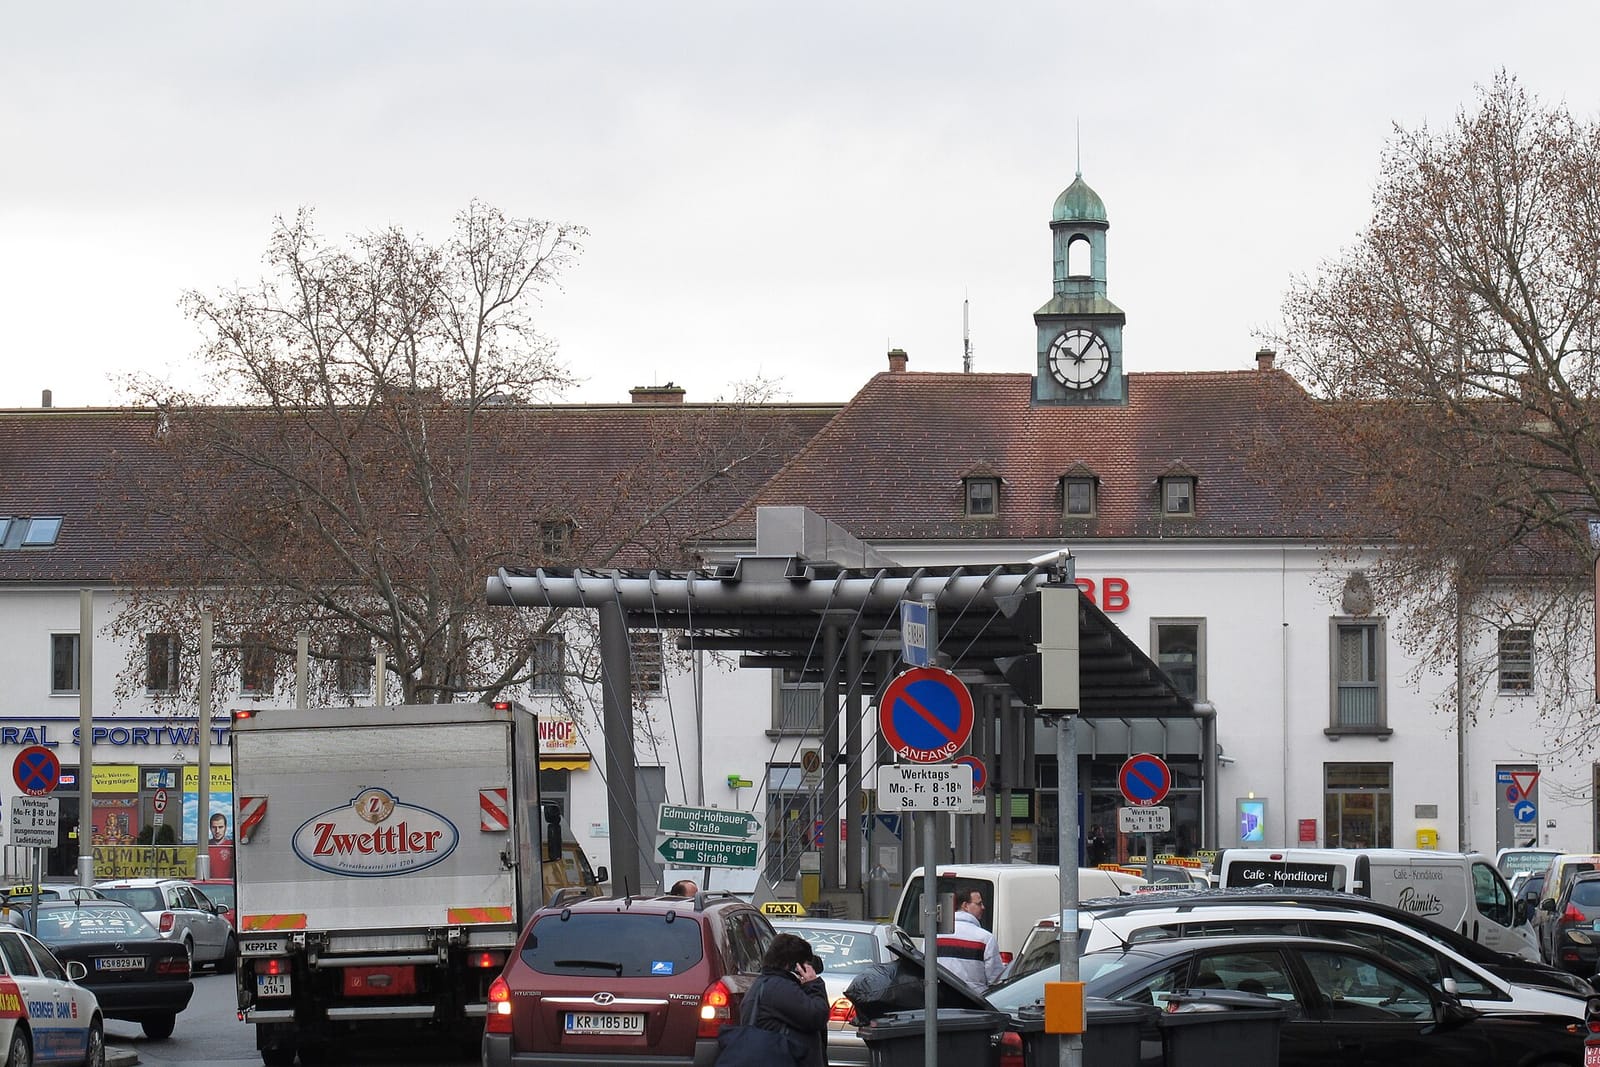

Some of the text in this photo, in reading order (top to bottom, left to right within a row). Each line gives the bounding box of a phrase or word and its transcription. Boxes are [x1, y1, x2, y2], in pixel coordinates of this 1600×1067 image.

[539, 721, 573, 740] NHOF
[898, 741, 958, 761] ANFANG
[901, 769, 950, 781] Werktags
[26, 788, 48, 796] ENDE
[22, 799, 49, 809] Werktags
[370, 798, 379, 813] Z
[901, 797, 918, 807] Sa.
[46, 809, 56, 817] Uhr
[663, 807, 748, 825] Edmund-Hofbauer-
[689, 821, 721, 833] Straße
[313, 821, 442, 856] Zwettler
[672, 839, 756, 856] Scheidtenberger-
[93, 847, 187, 865] ADMIRAL
[697, 852, 729, 864] Straße
[1243, 869, 1328, 883] Cafe Konditorei
[1413, 869, 1443, 880] Konditorei
[767, 904, 798, 913] TAXI
[245, 942, 278, 951] KEPPLER
[101, 959, 143, 968] KS 829 AW
[268, 976, 278, 985] ZT
[263, 985, 285, 994] 314 J
[28, 1001, 55, 1018] KREMSER
[56, 1001, 71, 1019] BANK
[576, 1016, 639, 1029] KR 185 BU
